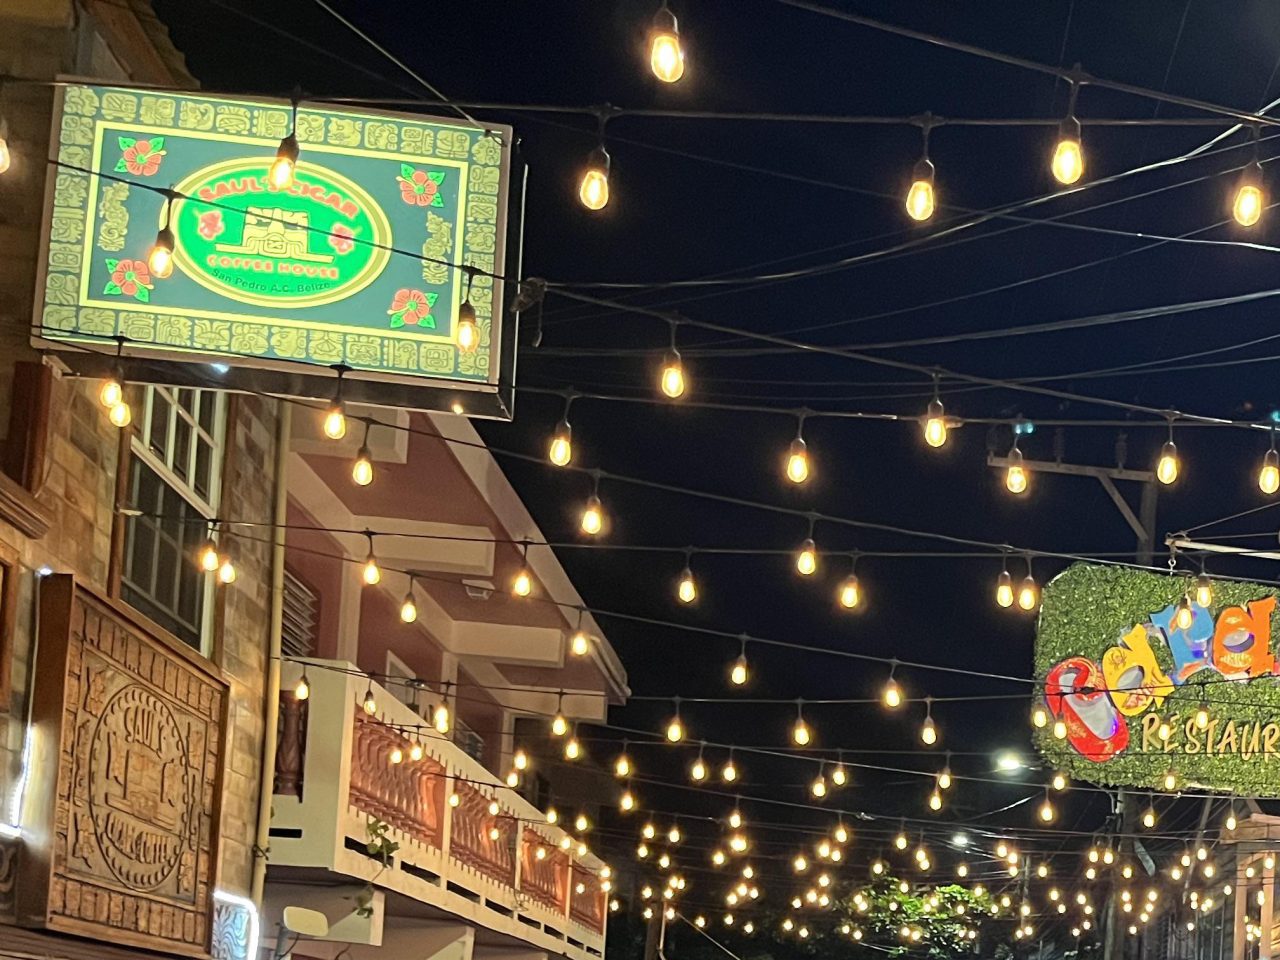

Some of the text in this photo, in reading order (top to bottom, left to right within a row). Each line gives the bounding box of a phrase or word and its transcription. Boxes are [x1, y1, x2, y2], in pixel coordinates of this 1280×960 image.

[207, 255, 339, 279] COFFEE HOUSE
[211, 267, 231, 283] San
[235, 277, 267, 293] Pedro
[297, 281, 331, 293] Belize
